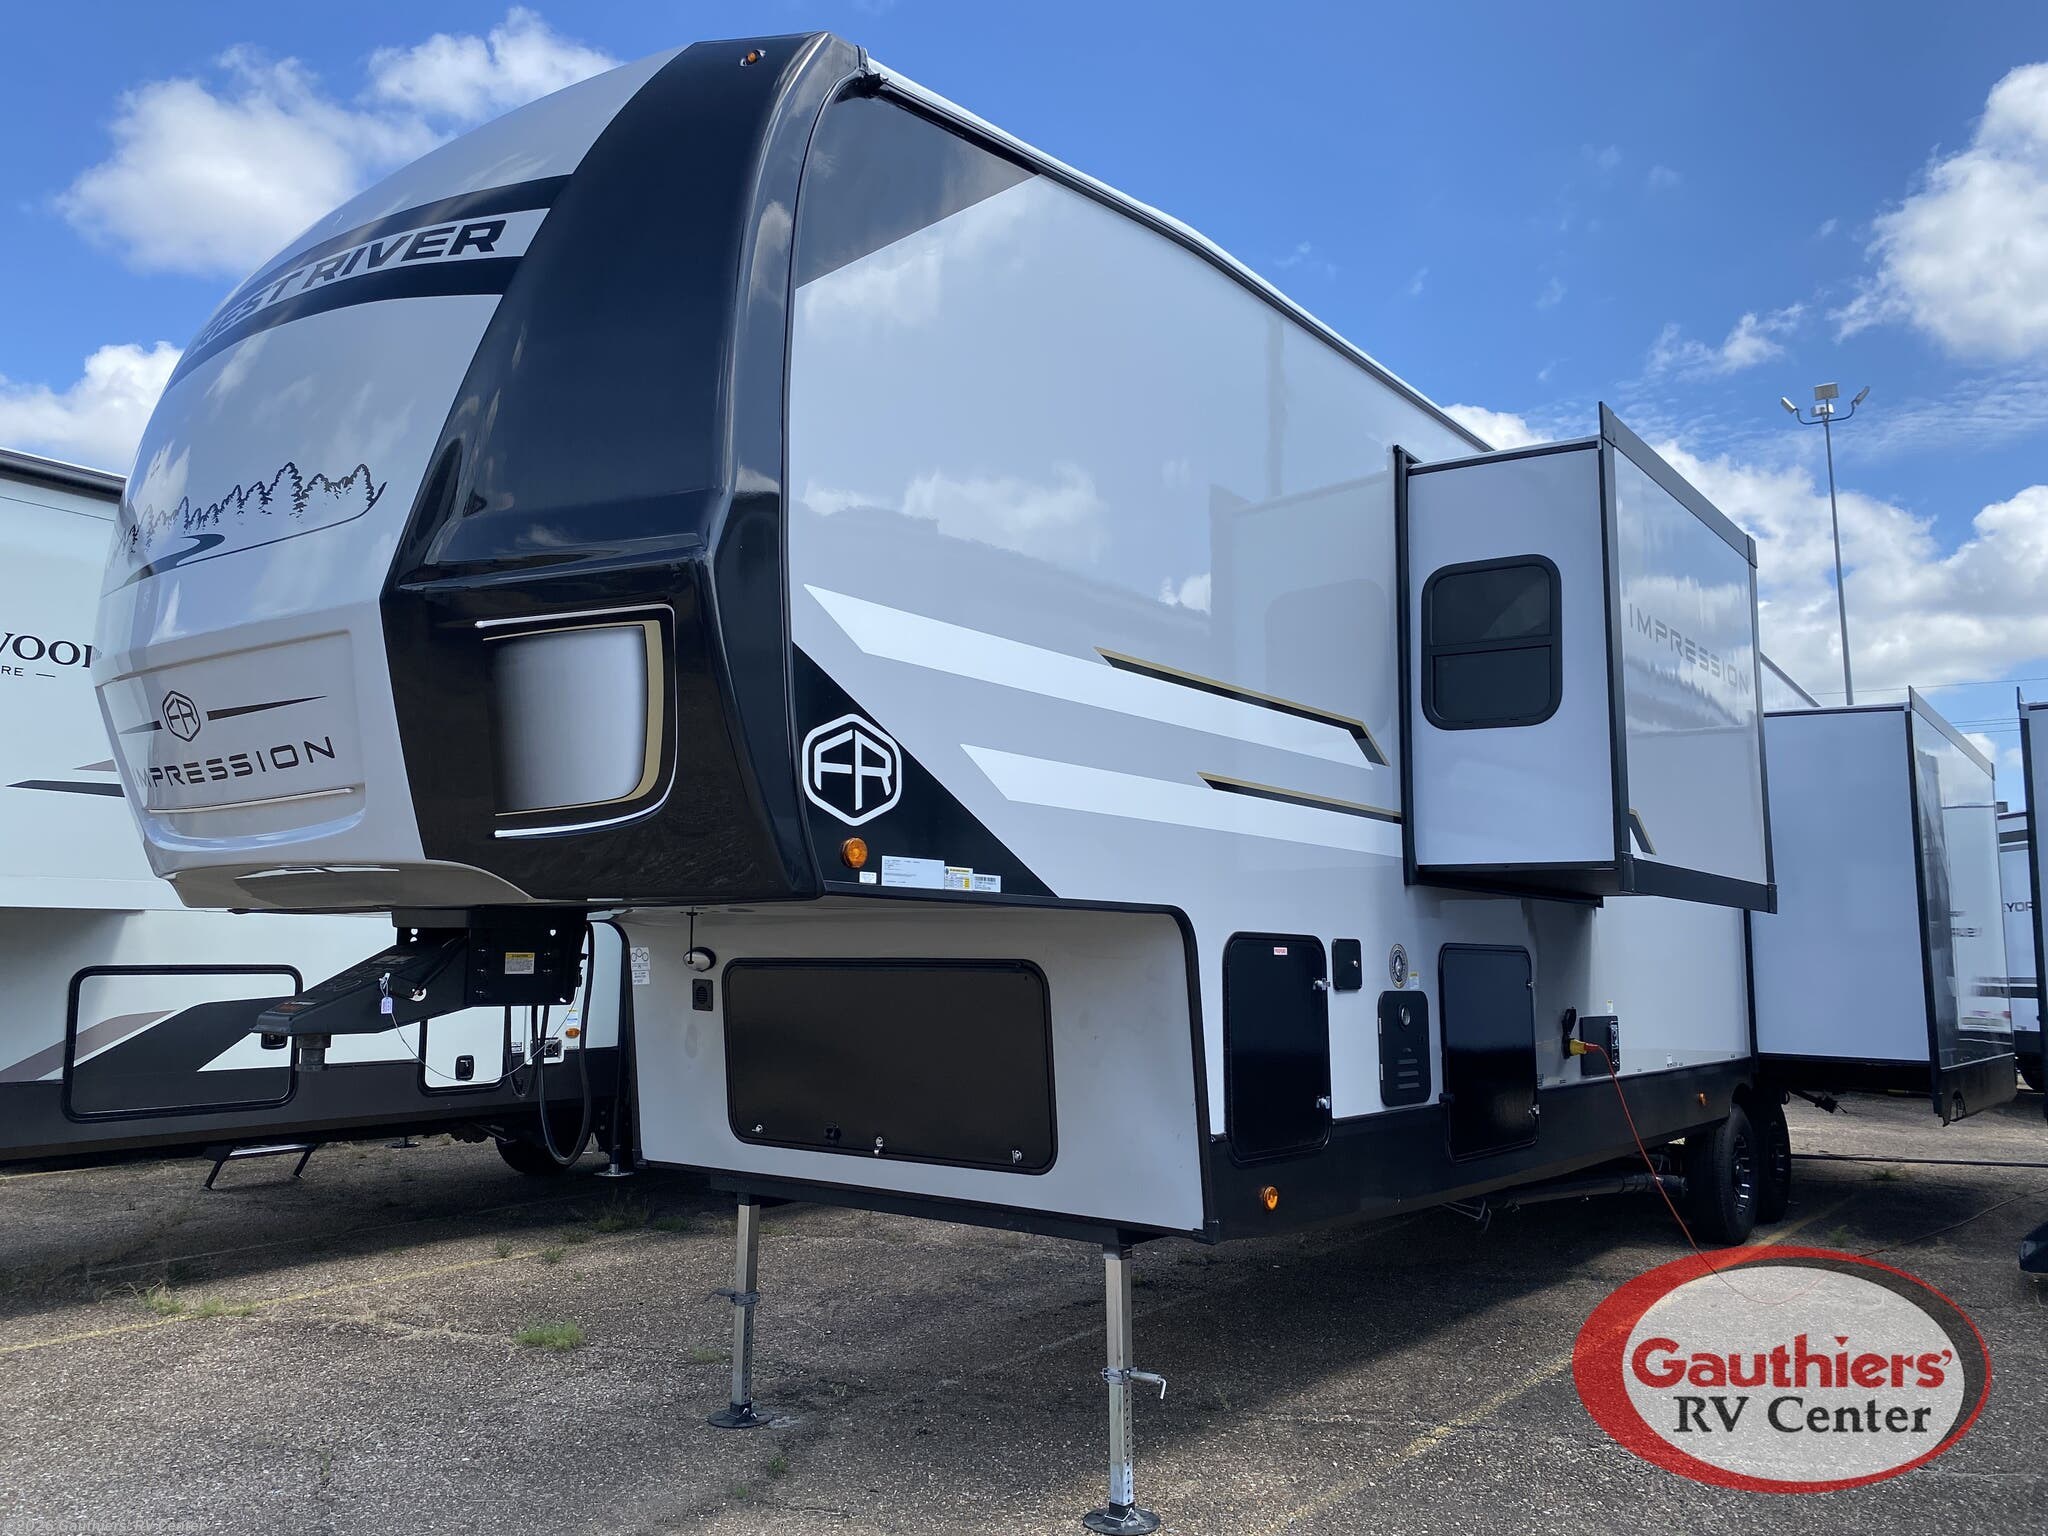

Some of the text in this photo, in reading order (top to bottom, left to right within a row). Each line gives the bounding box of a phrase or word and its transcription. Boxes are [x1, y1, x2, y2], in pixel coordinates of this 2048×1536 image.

[301, 219, 507, 290] RIVER
[1628, 603, 1749, 695] IMPRESSION
[132, 736, 336, 788] IMPRESSION
